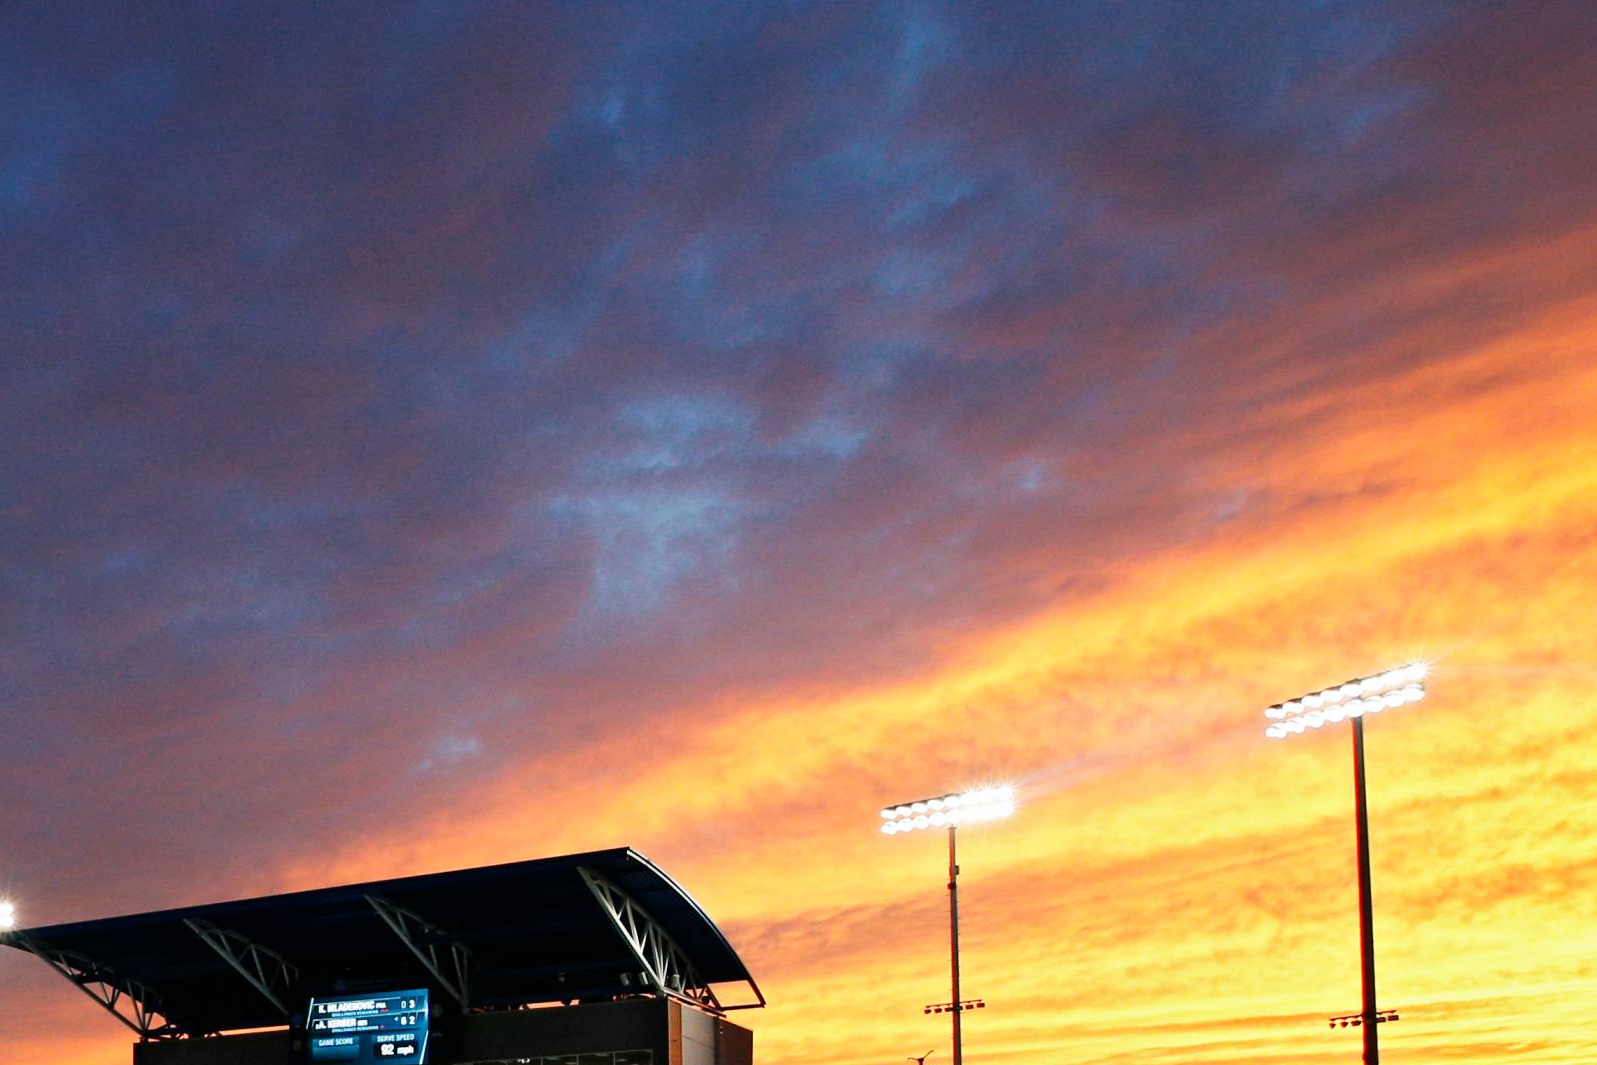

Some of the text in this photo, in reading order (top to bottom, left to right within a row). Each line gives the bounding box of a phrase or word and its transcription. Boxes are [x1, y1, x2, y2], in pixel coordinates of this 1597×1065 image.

[327, 1001, 375, 1012] MLADENOVIC
[327, 1018, 357, 1028] KERBER
[318, 1037, 354, 1046] GAME SCORE
[377, 1033, 415, 1042] SERVE SPEED
[381, 1044, 414, 1055] 92 mph
